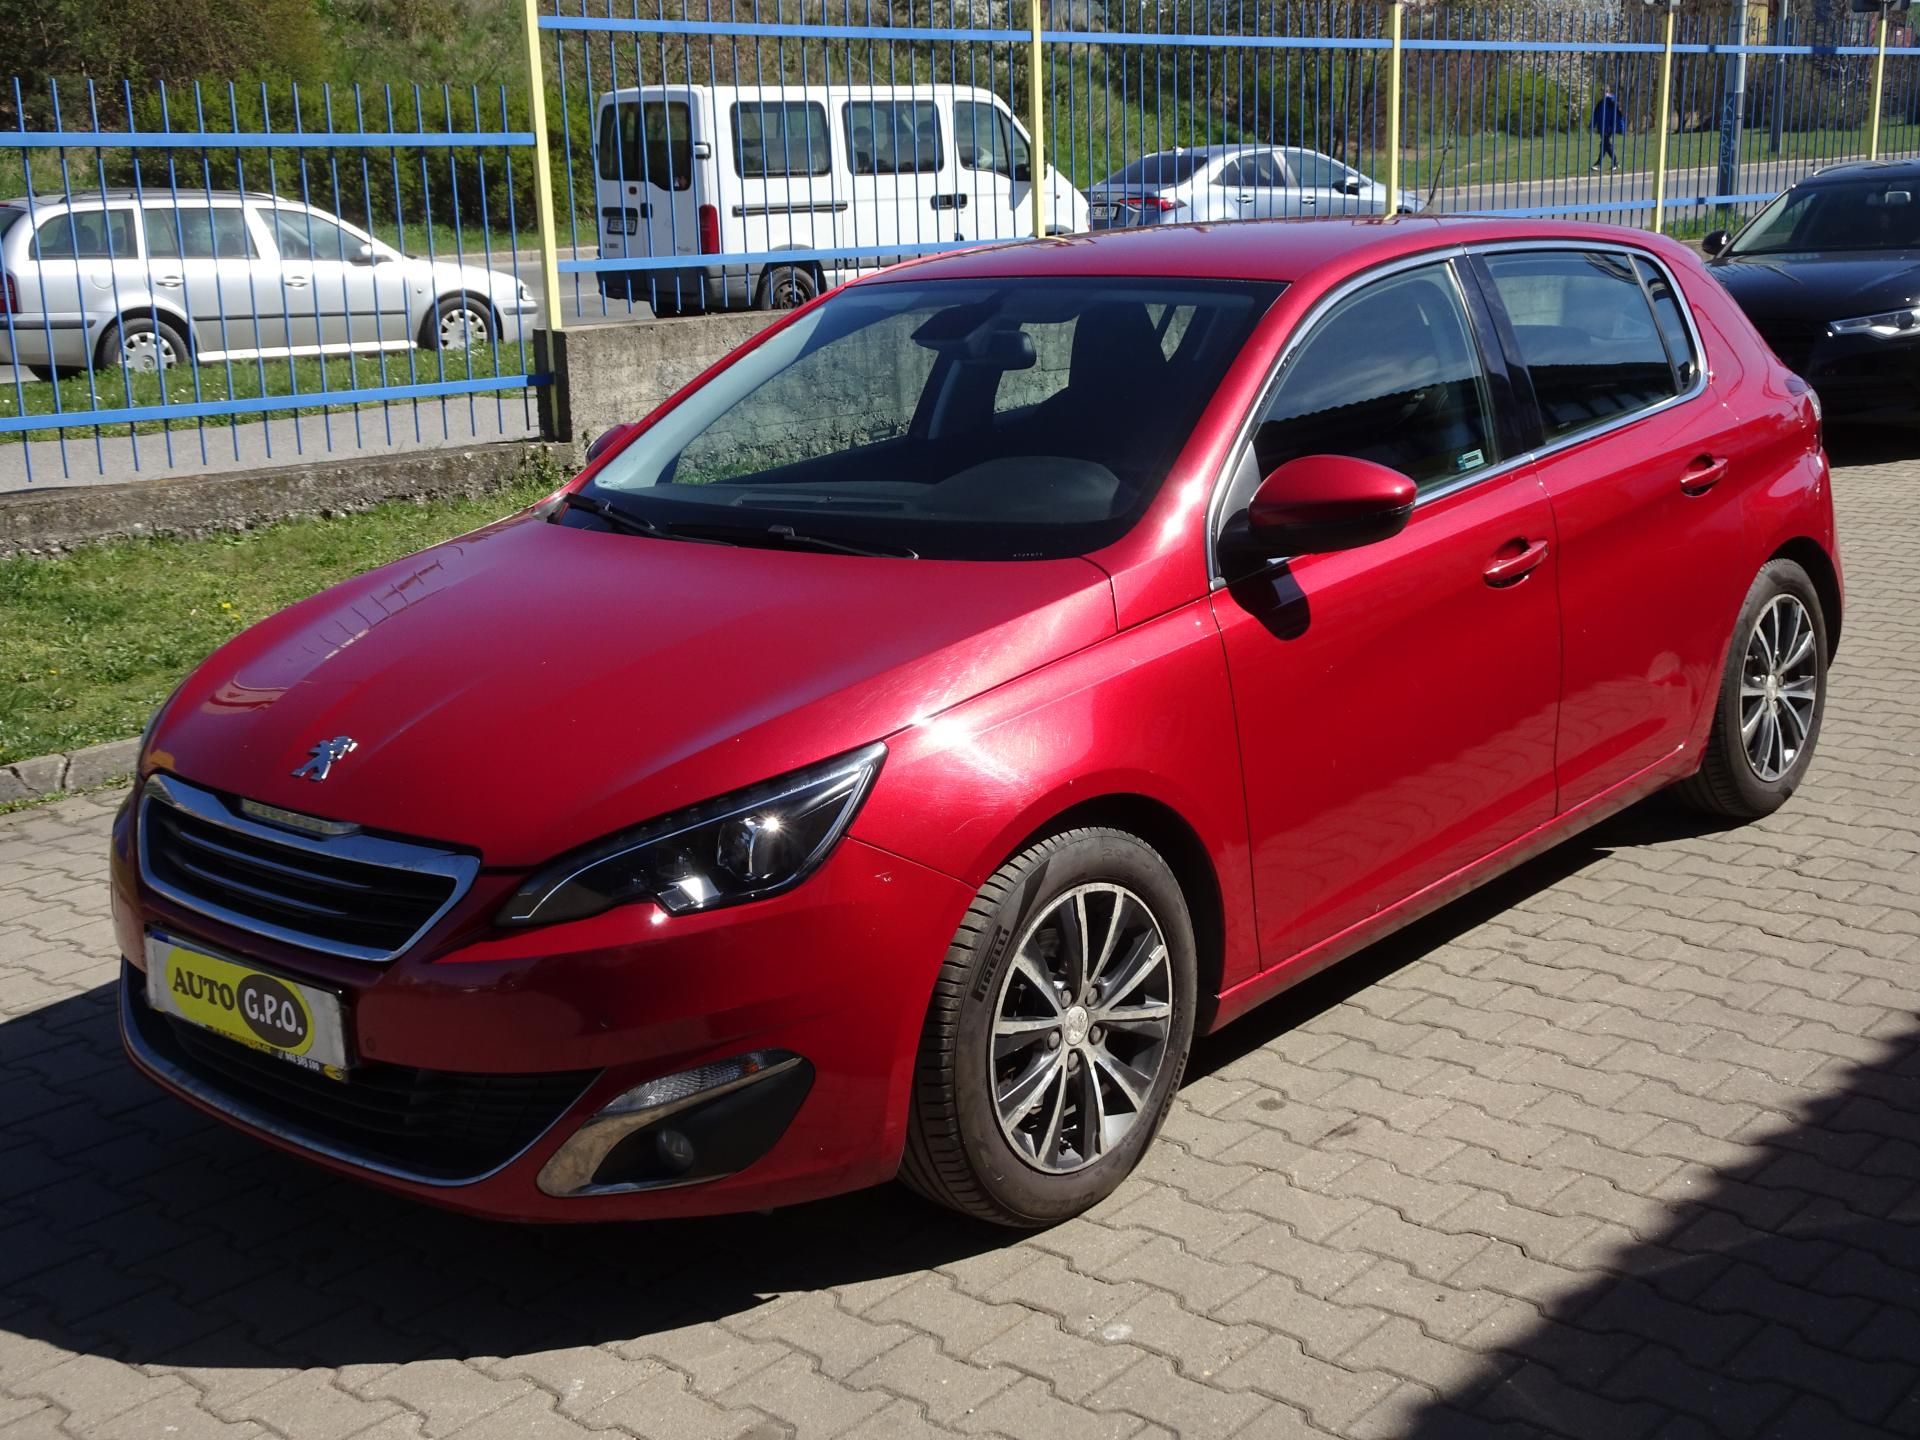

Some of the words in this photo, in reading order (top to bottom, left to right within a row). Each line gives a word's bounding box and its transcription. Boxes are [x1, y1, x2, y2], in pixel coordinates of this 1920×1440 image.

[970, 924, 1010, 1003] PIRELLI
[173, 966, 236, 1011] AUTO
[243, 987, 304, 1036] G.P.O.
